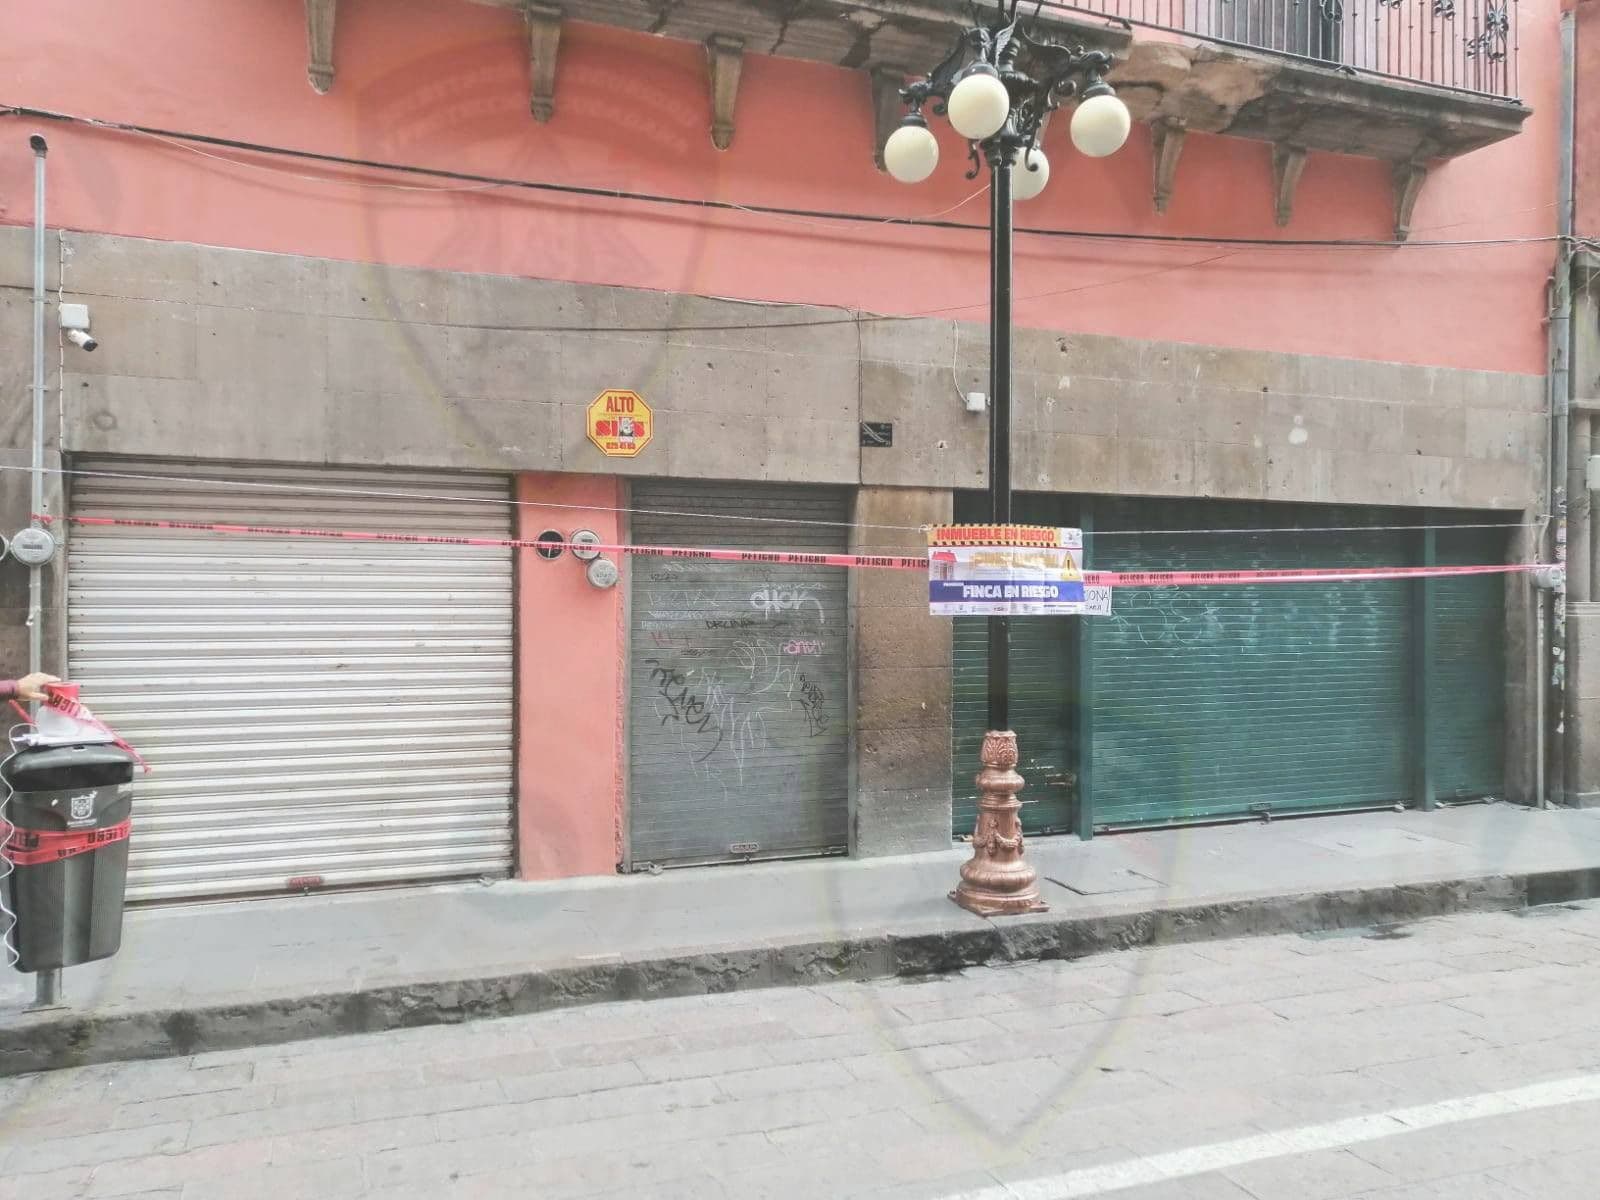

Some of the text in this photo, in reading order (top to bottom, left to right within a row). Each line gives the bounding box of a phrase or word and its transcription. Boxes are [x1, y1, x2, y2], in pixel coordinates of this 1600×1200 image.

[606, 396, 634, 412] ALTO
[936, 527, 1055, 542] INMUEBLE EN RIESGO
[741, 552, 780, 562] PELIGRO
[788, 554, 827, 563] PELIGRO
[855, 556, 893, 566] PELIGRO
[901, 558, 930, 568] PELIG
[962, 585, 1059, 598] FINCA EN RIESGO
